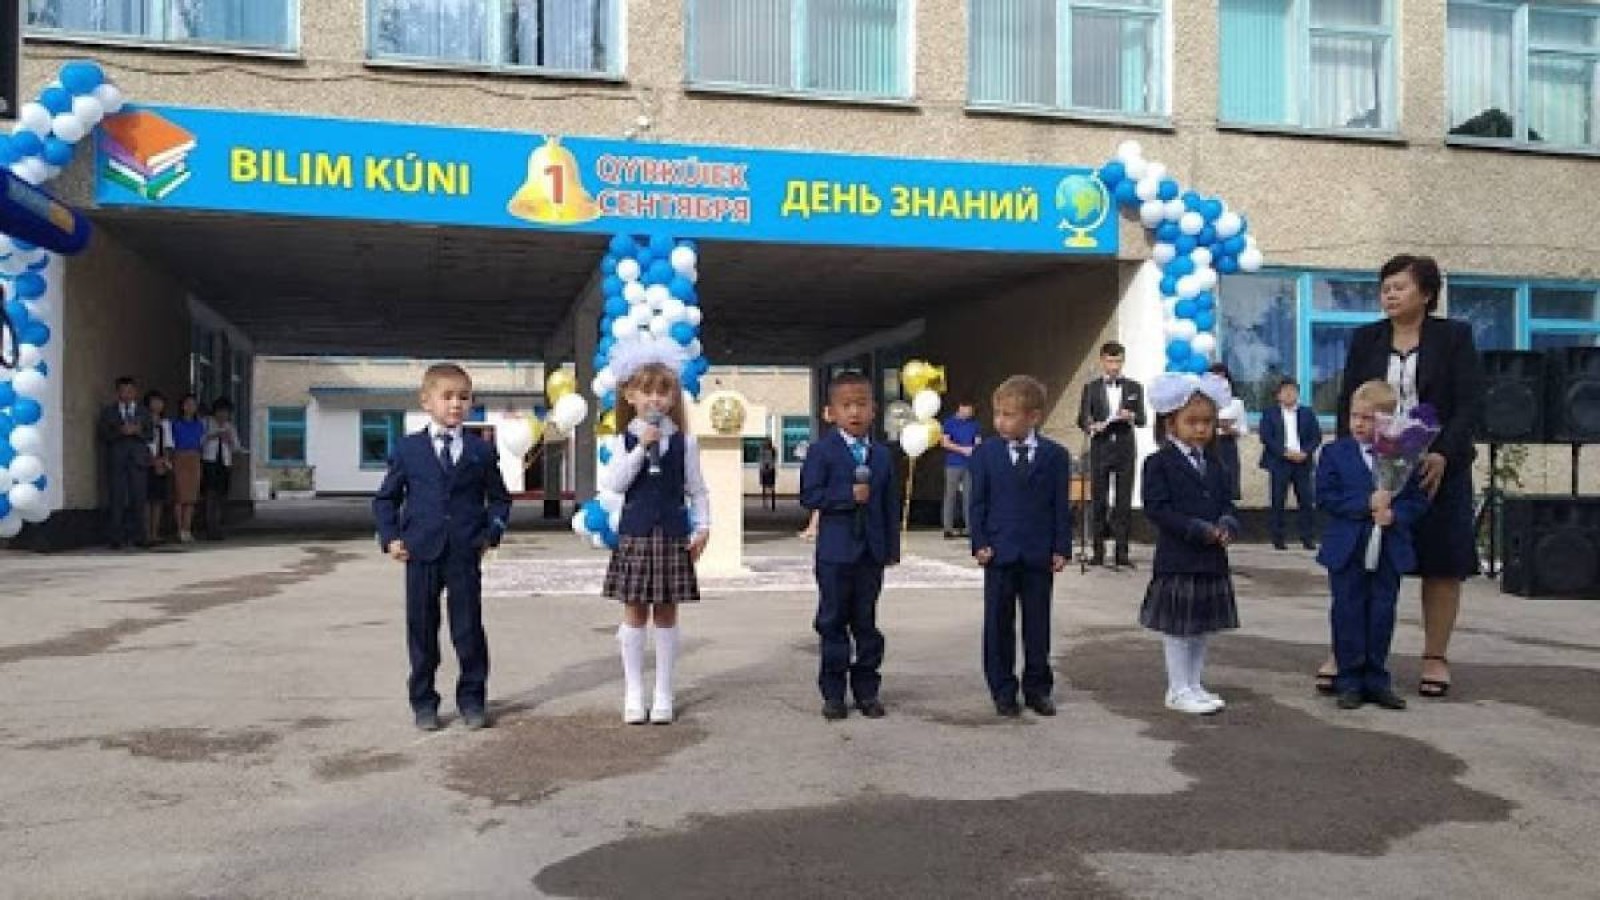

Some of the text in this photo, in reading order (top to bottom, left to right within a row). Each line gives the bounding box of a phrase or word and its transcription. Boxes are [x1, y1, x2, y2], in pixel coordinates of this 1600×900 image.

[230, 148, 470, 195] BILIM KÚNI
[543, 165, 563, 204] 1
[597, 189, 751, 223] СЕНТЯБРЯ
[780, 180, 1039, 223] ДЕНЬ ЗНАНИЙ
